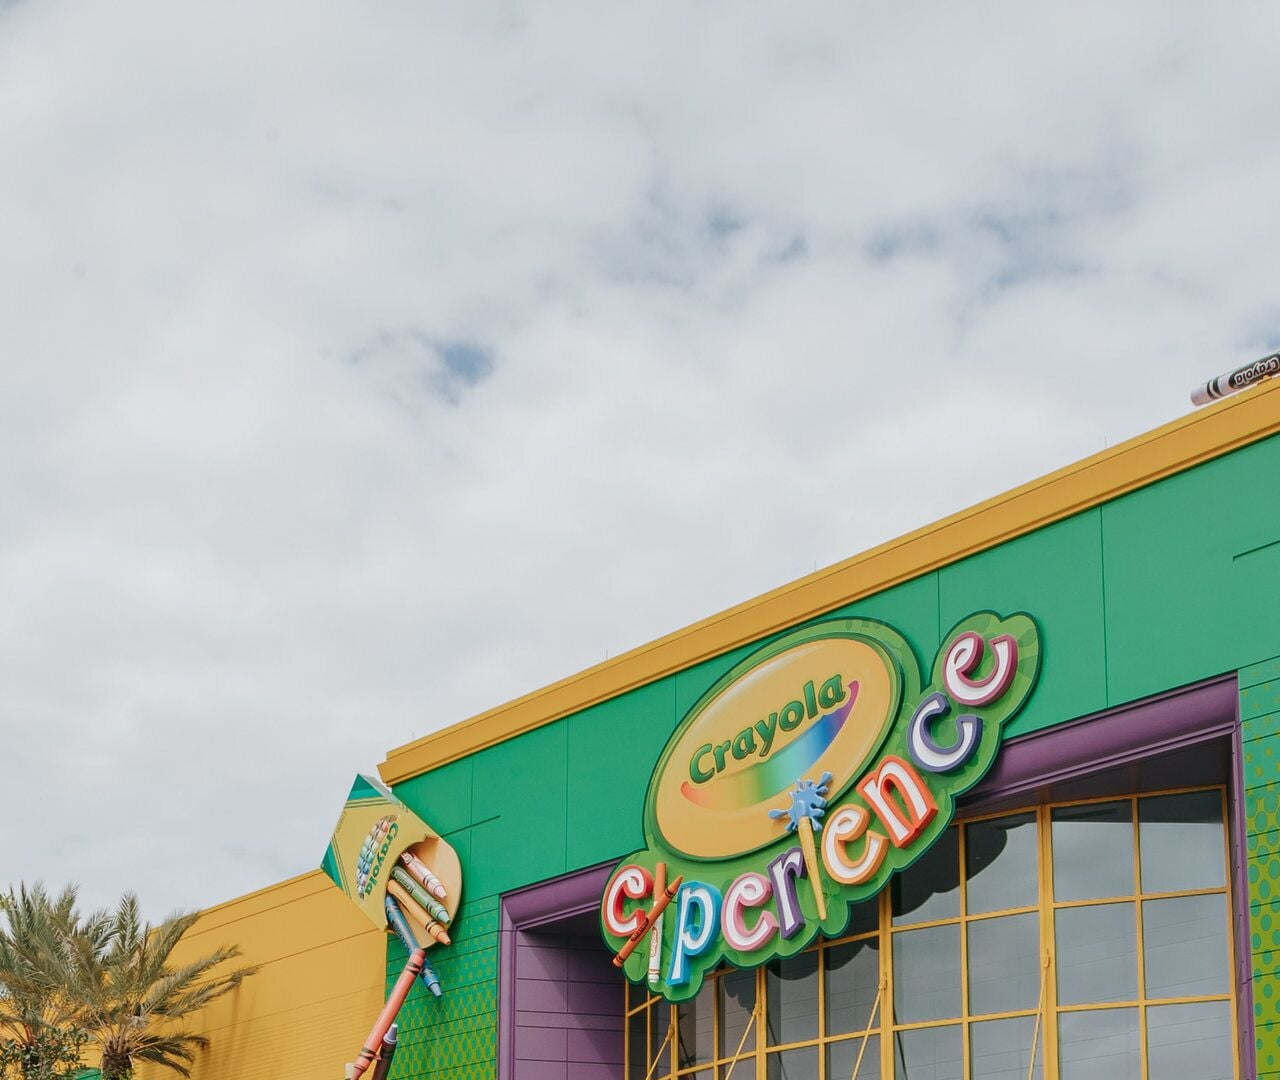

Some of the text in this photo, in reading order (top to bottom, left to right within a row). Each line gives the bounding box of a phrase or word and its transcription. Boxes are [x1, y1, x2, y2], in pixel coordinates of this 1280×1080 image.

[1233, 356, 1280, 385] Crayola
[689, 673, 847, 784] Crayola
[365, 822, 398, 896] Crayola
